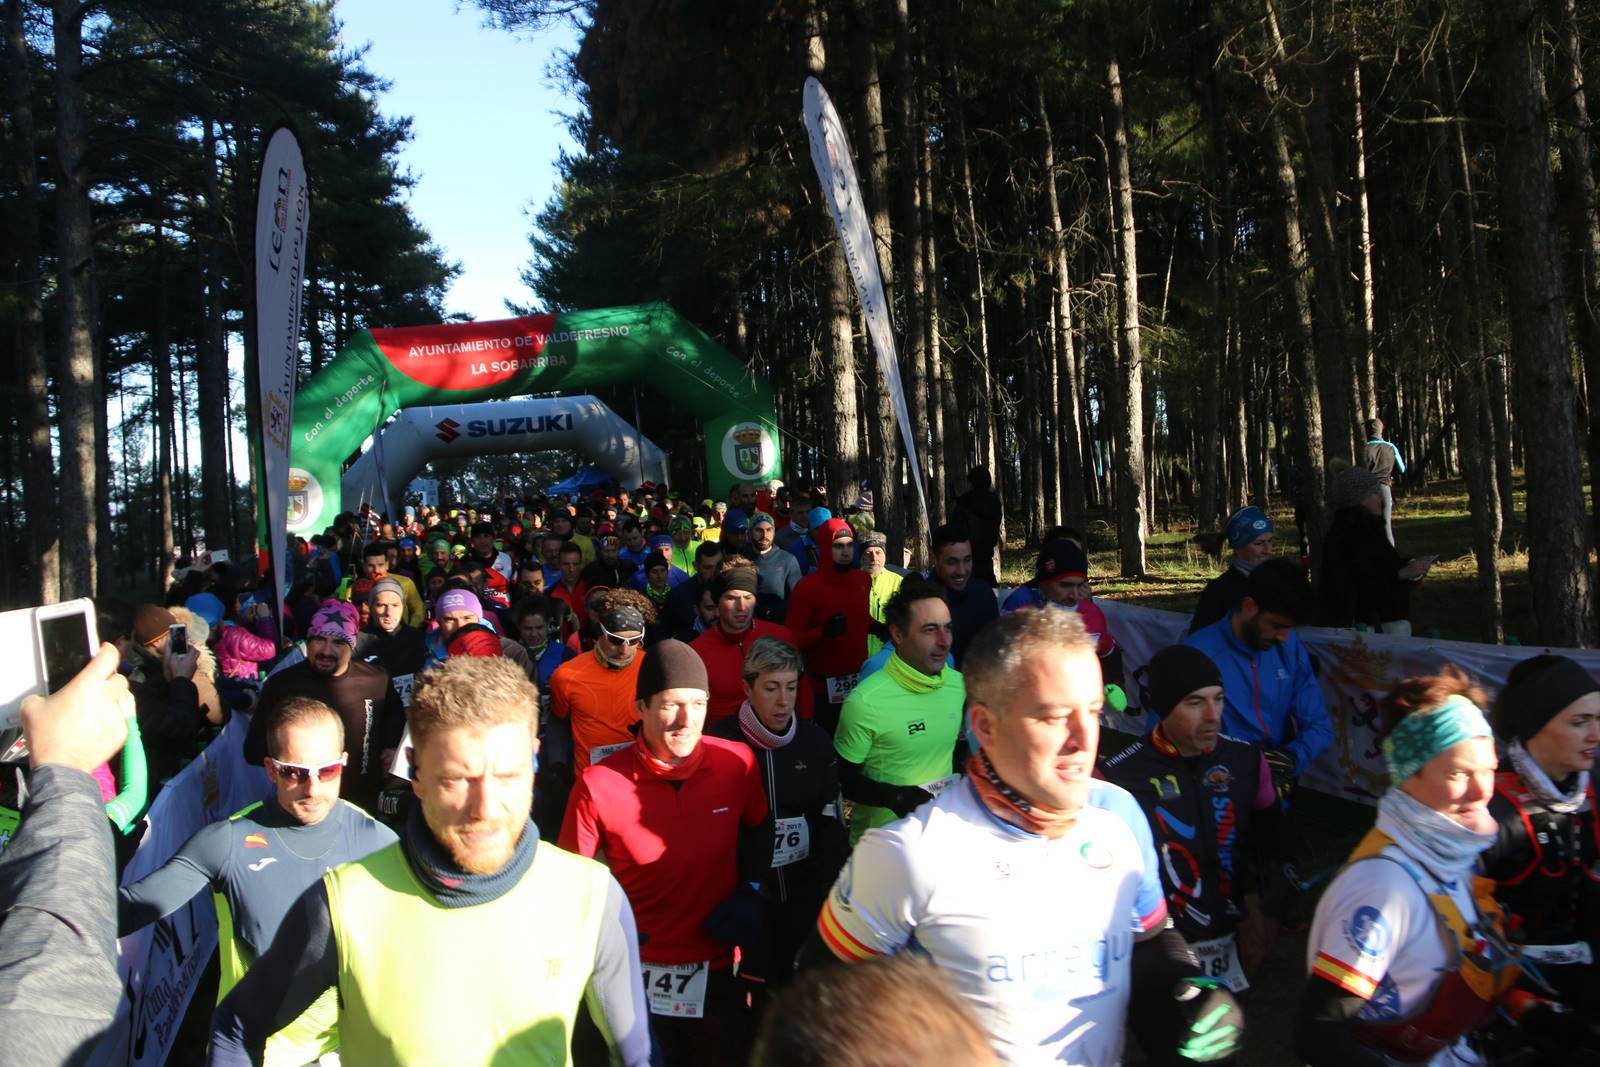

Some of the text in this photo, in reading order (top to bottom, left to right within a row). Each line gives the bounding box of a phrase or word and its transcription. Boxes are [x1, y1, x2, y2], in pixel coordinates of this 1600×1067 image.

[408, 325, 630, 358] AYUNTAMIENTO DE VALDEFRESNO
[471, 354, 567, 375] LA SOBARRIBA
[665, 345, 739, 399] Con el deporte
[305, 374, 375, 442] Con el deporte
[467, 413, 573, 438] SUZUKI
[835, 679, 858, 692] 299
[642, 970, 691, 995] 147
